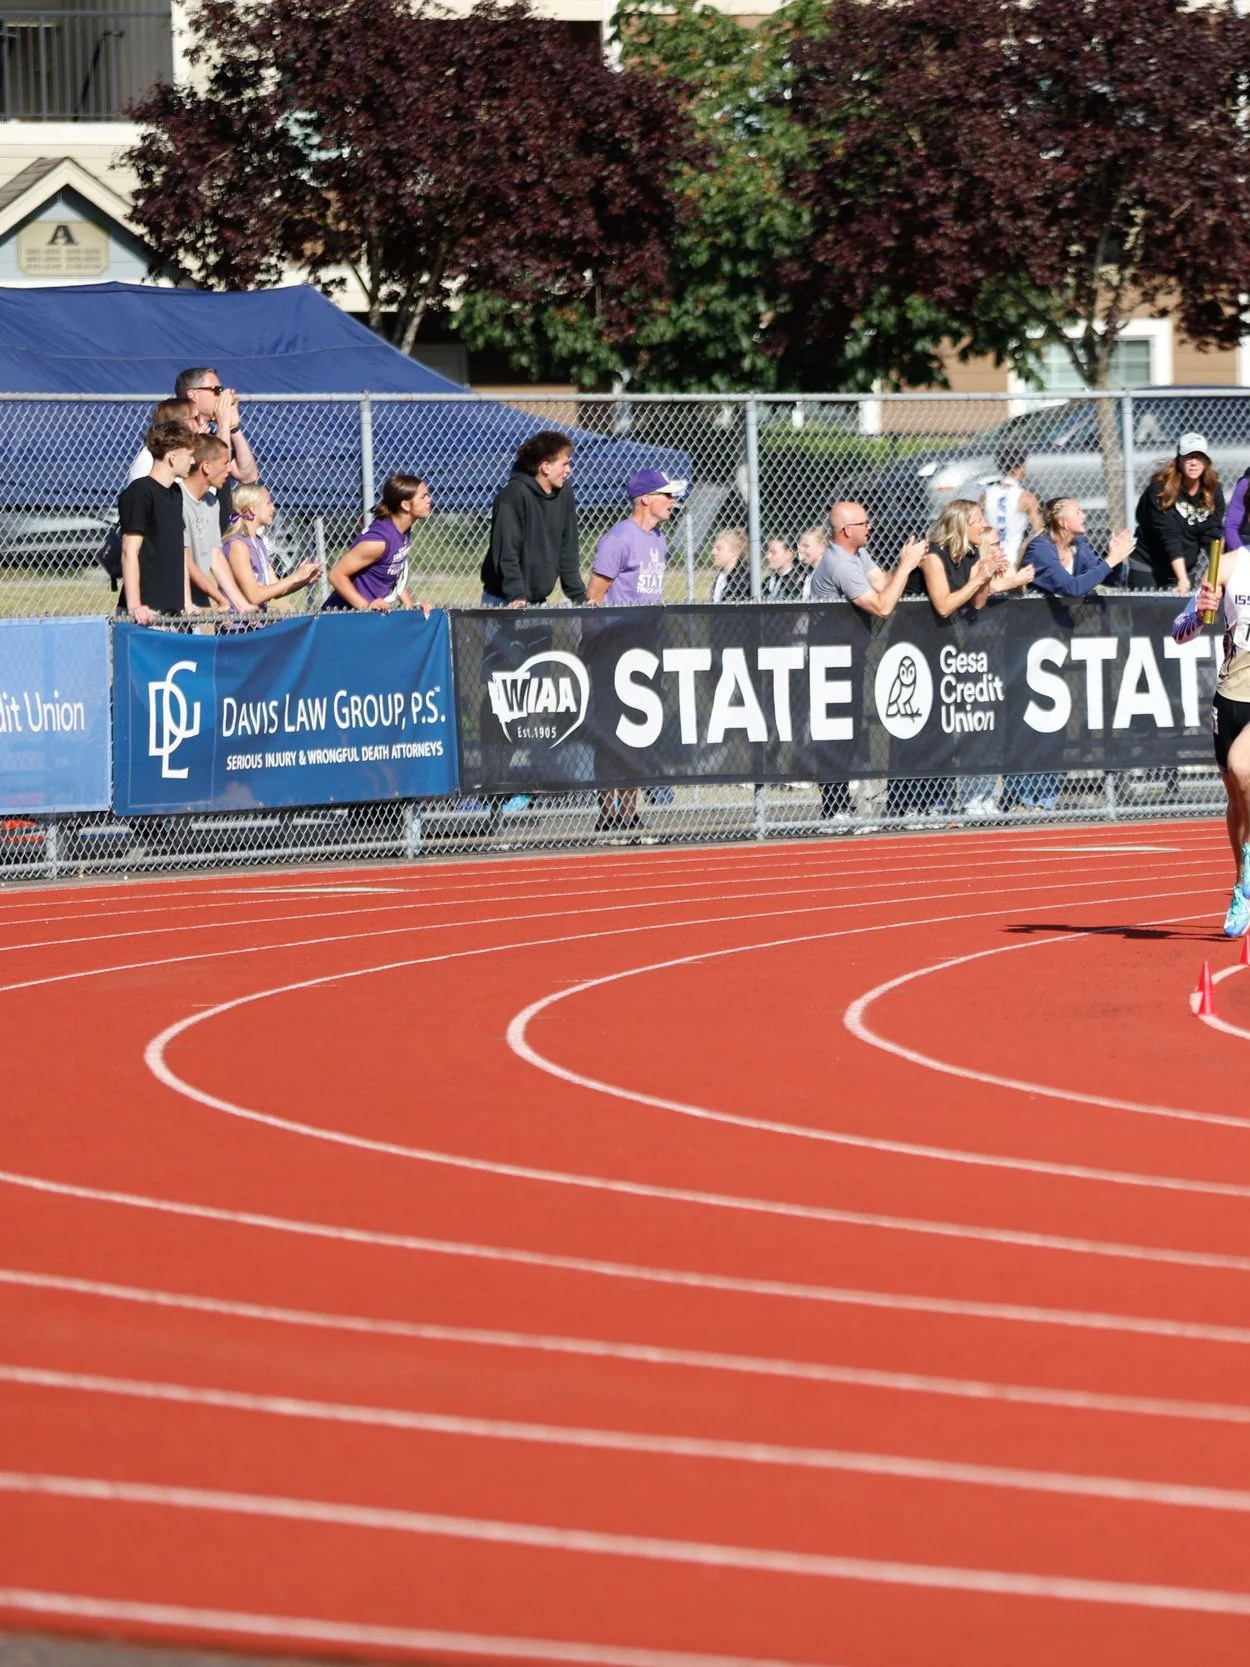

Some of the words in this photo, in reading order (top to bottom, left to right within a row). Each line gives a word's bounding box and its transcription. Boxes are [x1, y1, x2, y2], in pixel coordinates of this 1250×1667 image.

[46, 224, 79, 246] A
[940, 645, 988, 674] Gesa
[492, 672, 578, 716] WIAA
[614, 645, 854, 748] STATE
[940, 673, 1004, 704] Credit
[1023, 637, 1224, 733] STAT
[24, 690, 84, 732] Union
[222, 697, 279, 737] DAVIS
[284, 693, 328, 733] LAW
[333, 689, 406, 731] GROUP,
[941, 704, 995, 733] Union
[226, 753, 262, 771] SERIOUS
[265, 751, 296, 768] INJURY
[299, 750, 306, 766] &
[308, 746, 360, 765] WRONGFUL
[362, 744, 390, 762] DEATH
[391, 740, 444, 760] ATTORNEYS
